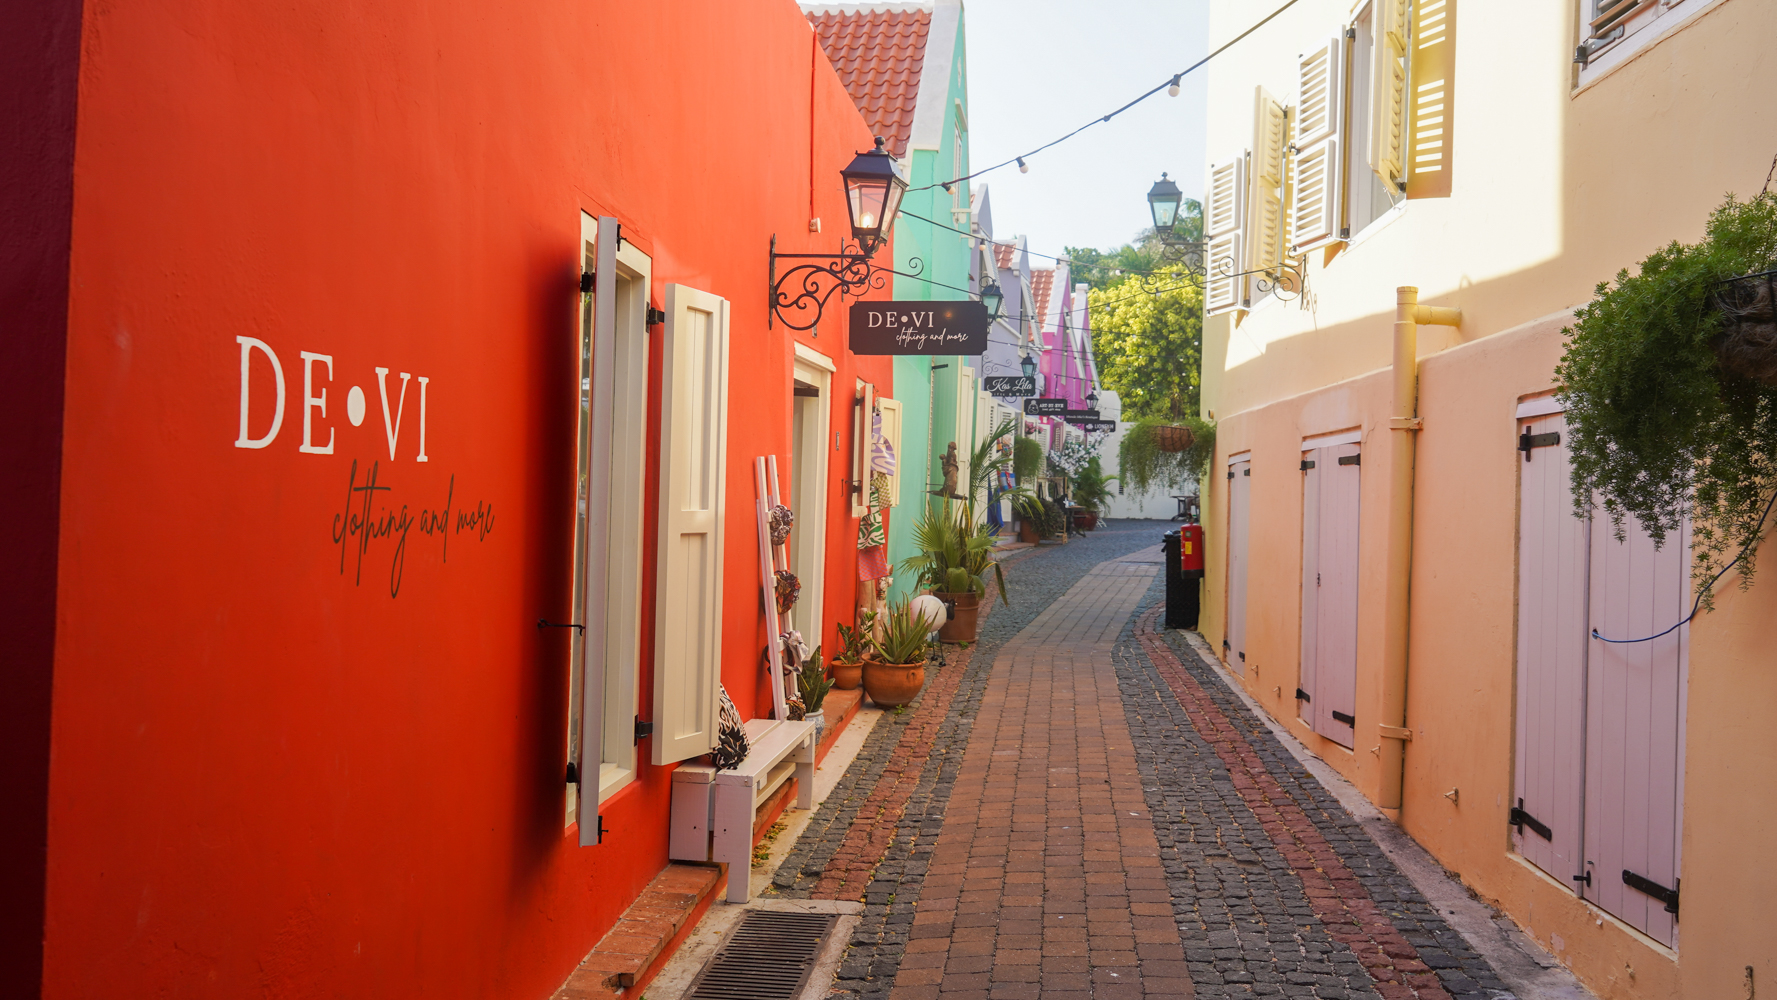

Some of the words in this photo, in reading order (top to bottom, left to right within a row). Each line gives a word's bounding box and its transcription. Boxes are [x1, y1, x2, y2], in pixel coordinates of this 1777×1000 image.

[895, 326, 928, 350] clothing
[929, 328, 946, 346] and
[946, 332, 969, 342] more
[986, 377, 1011, 392] Kas
[332, 458, 414, 600] clothing
[420, 472, 455, 564] and
[456, 500, 495, 543] more
